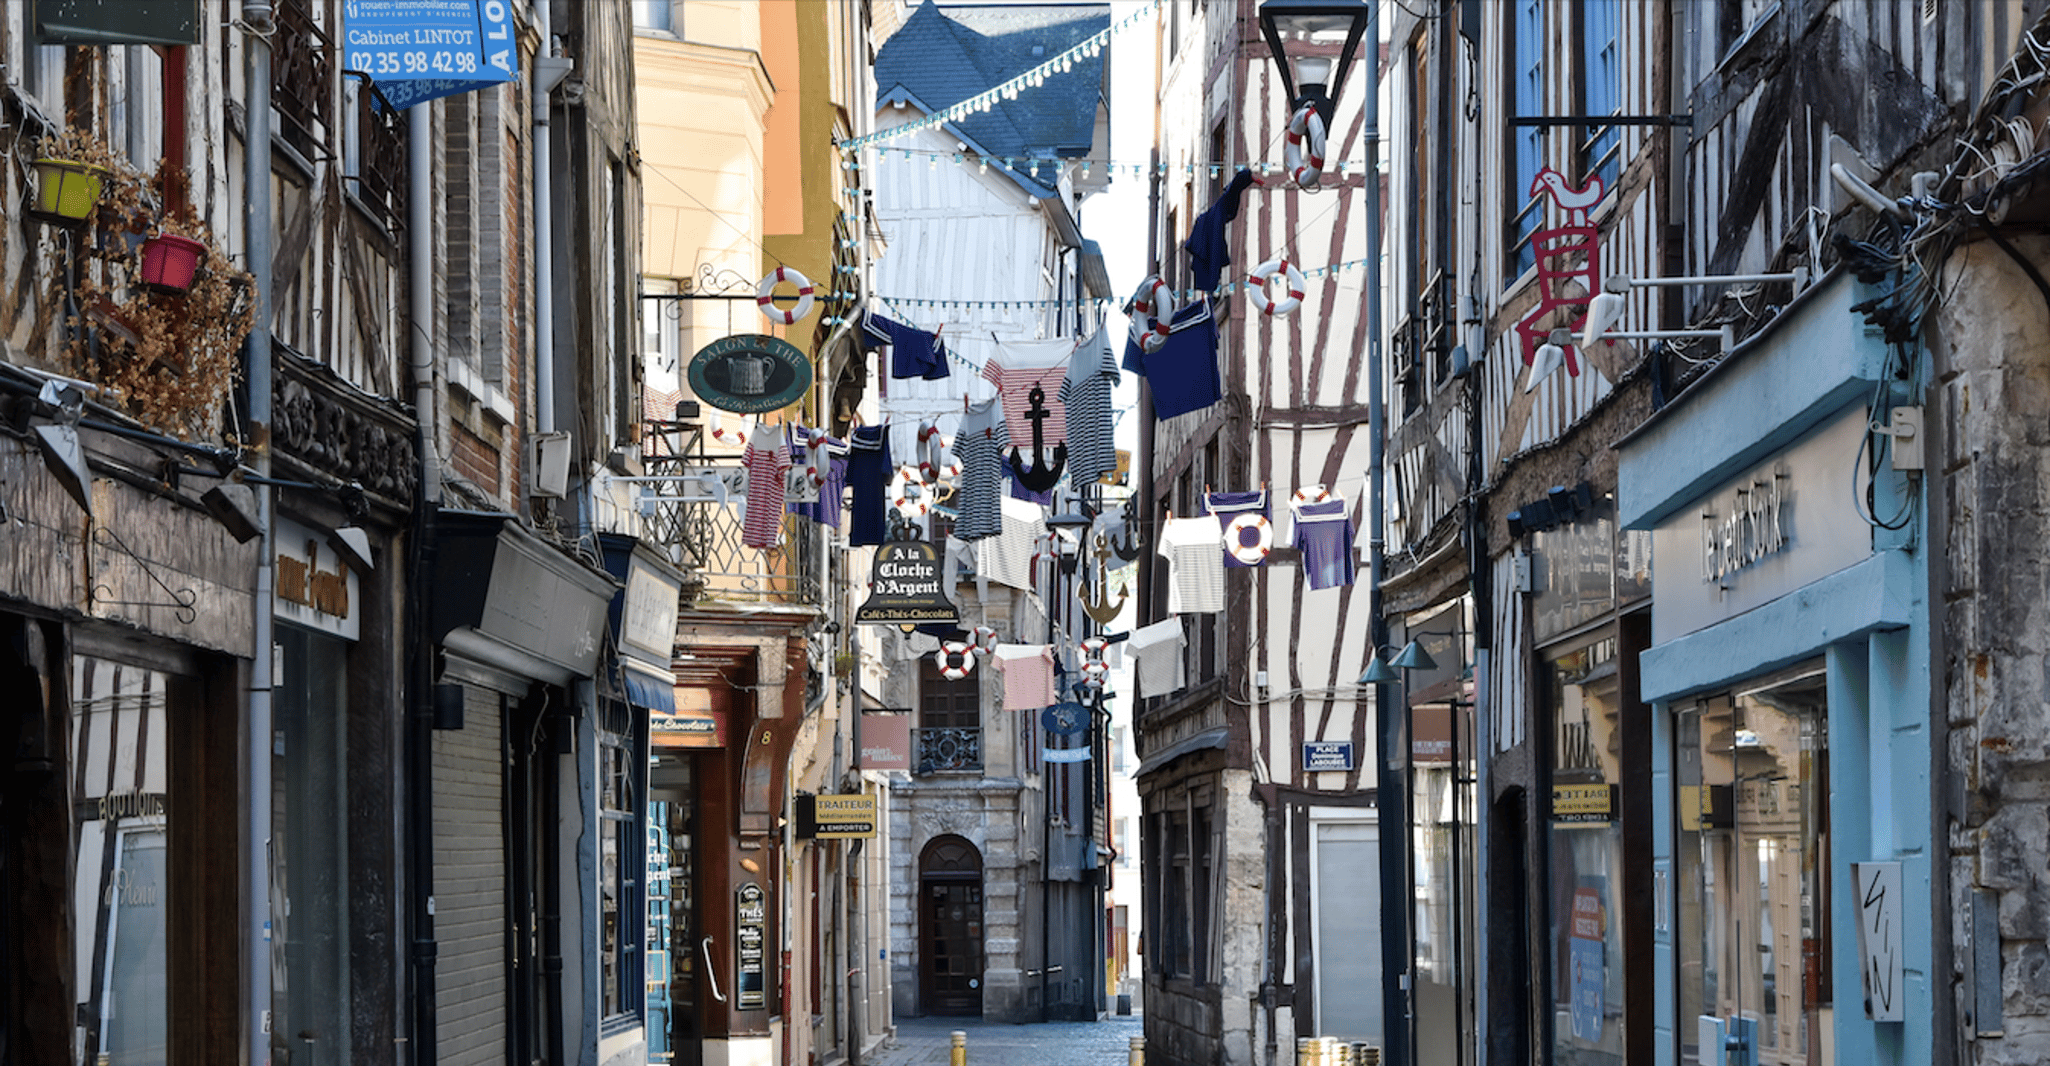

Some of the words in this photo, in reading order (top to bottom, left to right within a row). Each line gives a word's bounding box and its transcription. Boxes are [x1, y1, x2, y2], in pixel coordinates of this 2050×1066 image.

[348, 30, 411, 45] Cabinet
[414, 29, 474, 45] LINTOT
[351, 51, 374, 73] 02
[376, 51, 400, 74] 35
[403, 51, 428, 74] 98
[432, 51, 454, 73] 42
[455, 51, 477, 74] 98
[490, 49, 510, 71] A
[396, 81, 413, 104] 35
[697, 338, 747, 366] SALON
[775, 343, 803, 368] THE
[1700, 507, 1714, 583] Le
[1717, 508, 1746, 604] petit
[1747, 473, 1783, 562] Souk
[894, 548, 904, 560] A
[907, 548, 920, 560] la
[879, 562, 934, 579] Cloche
[876, 580, 939, 597] d'Argent
[761, 730, 771, 745] 8
[1316, 745, 1339, 753] PLACE
[818, 800, 872, 809] TRAITEUR
[828, 824, 870, 832] EMPORTER
